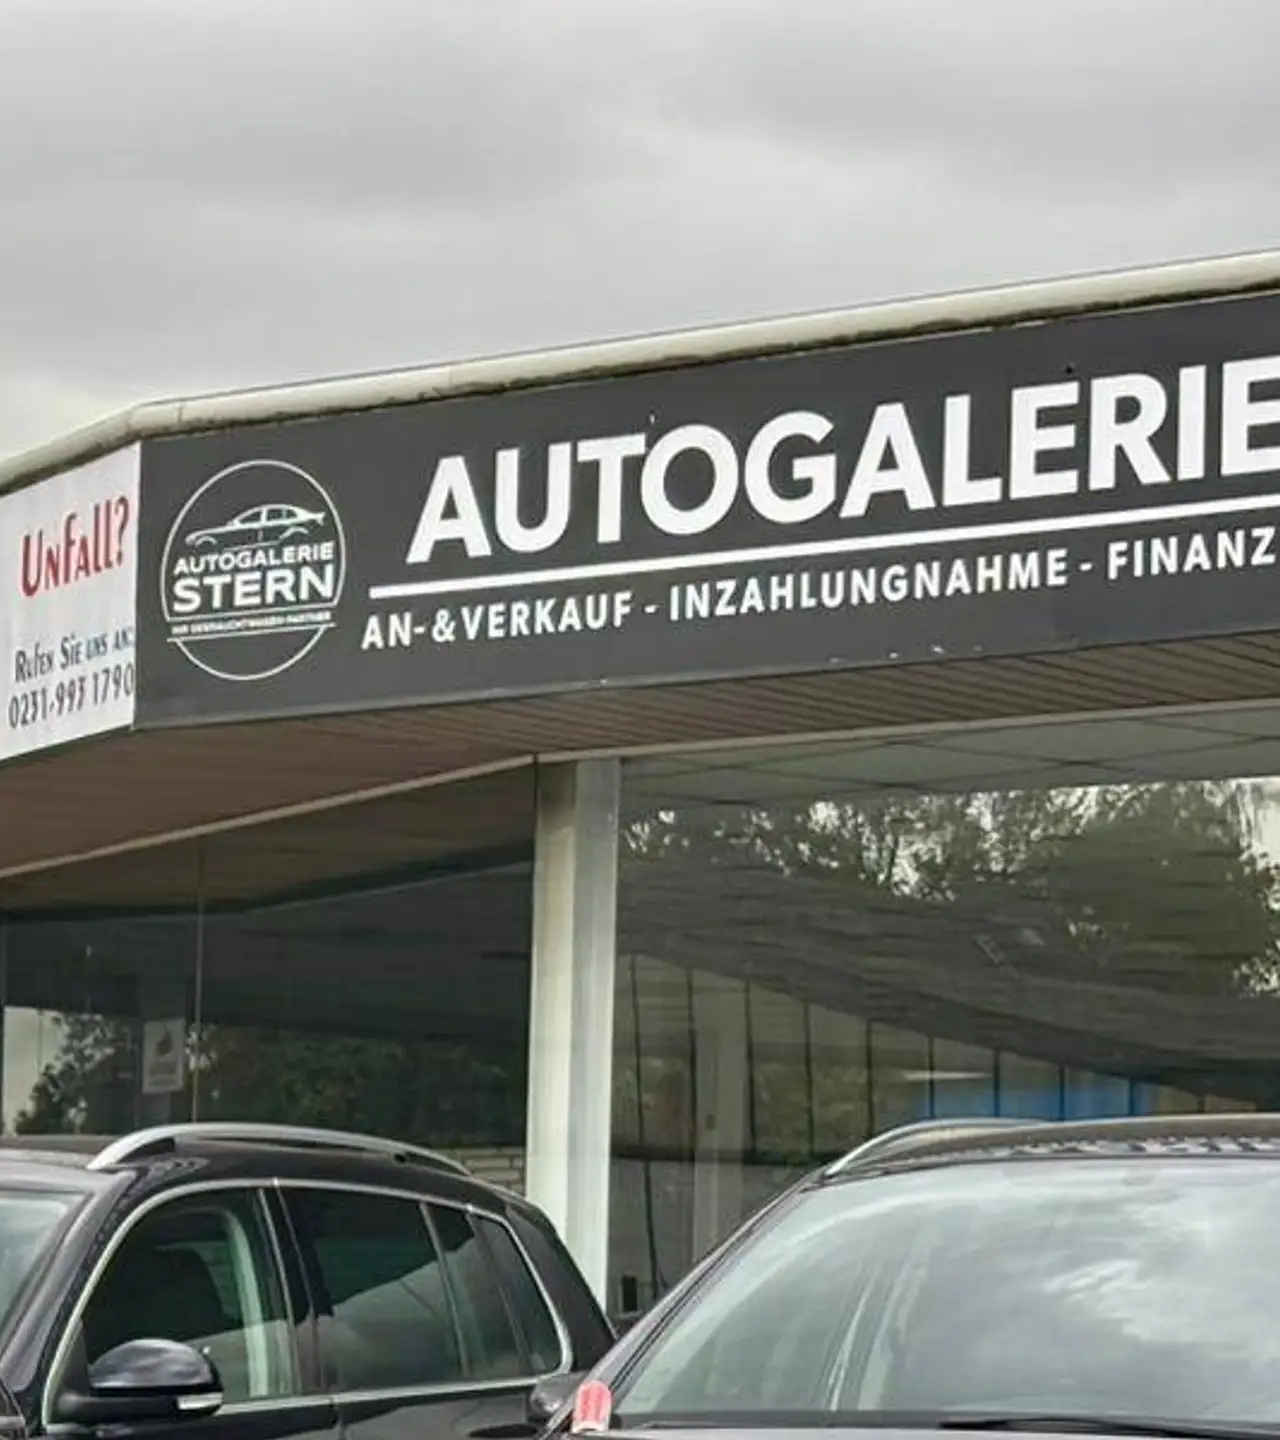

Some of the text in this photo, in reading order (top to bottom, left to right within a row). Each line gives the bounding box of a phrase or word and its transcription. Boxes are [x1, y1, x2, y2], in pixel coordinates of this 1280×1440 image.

[405, 354, 1280, 565] AUTOGALERIE
[173, 541, 334, 576] AUTOGALERIE
[670, 549, 1068, 621] INZAHLUNGNAHME
[1108, 524, 1276, 578] FINANZ
[173, 564, 334, 613] STERN
[60, 632, 83, 670] Sie
